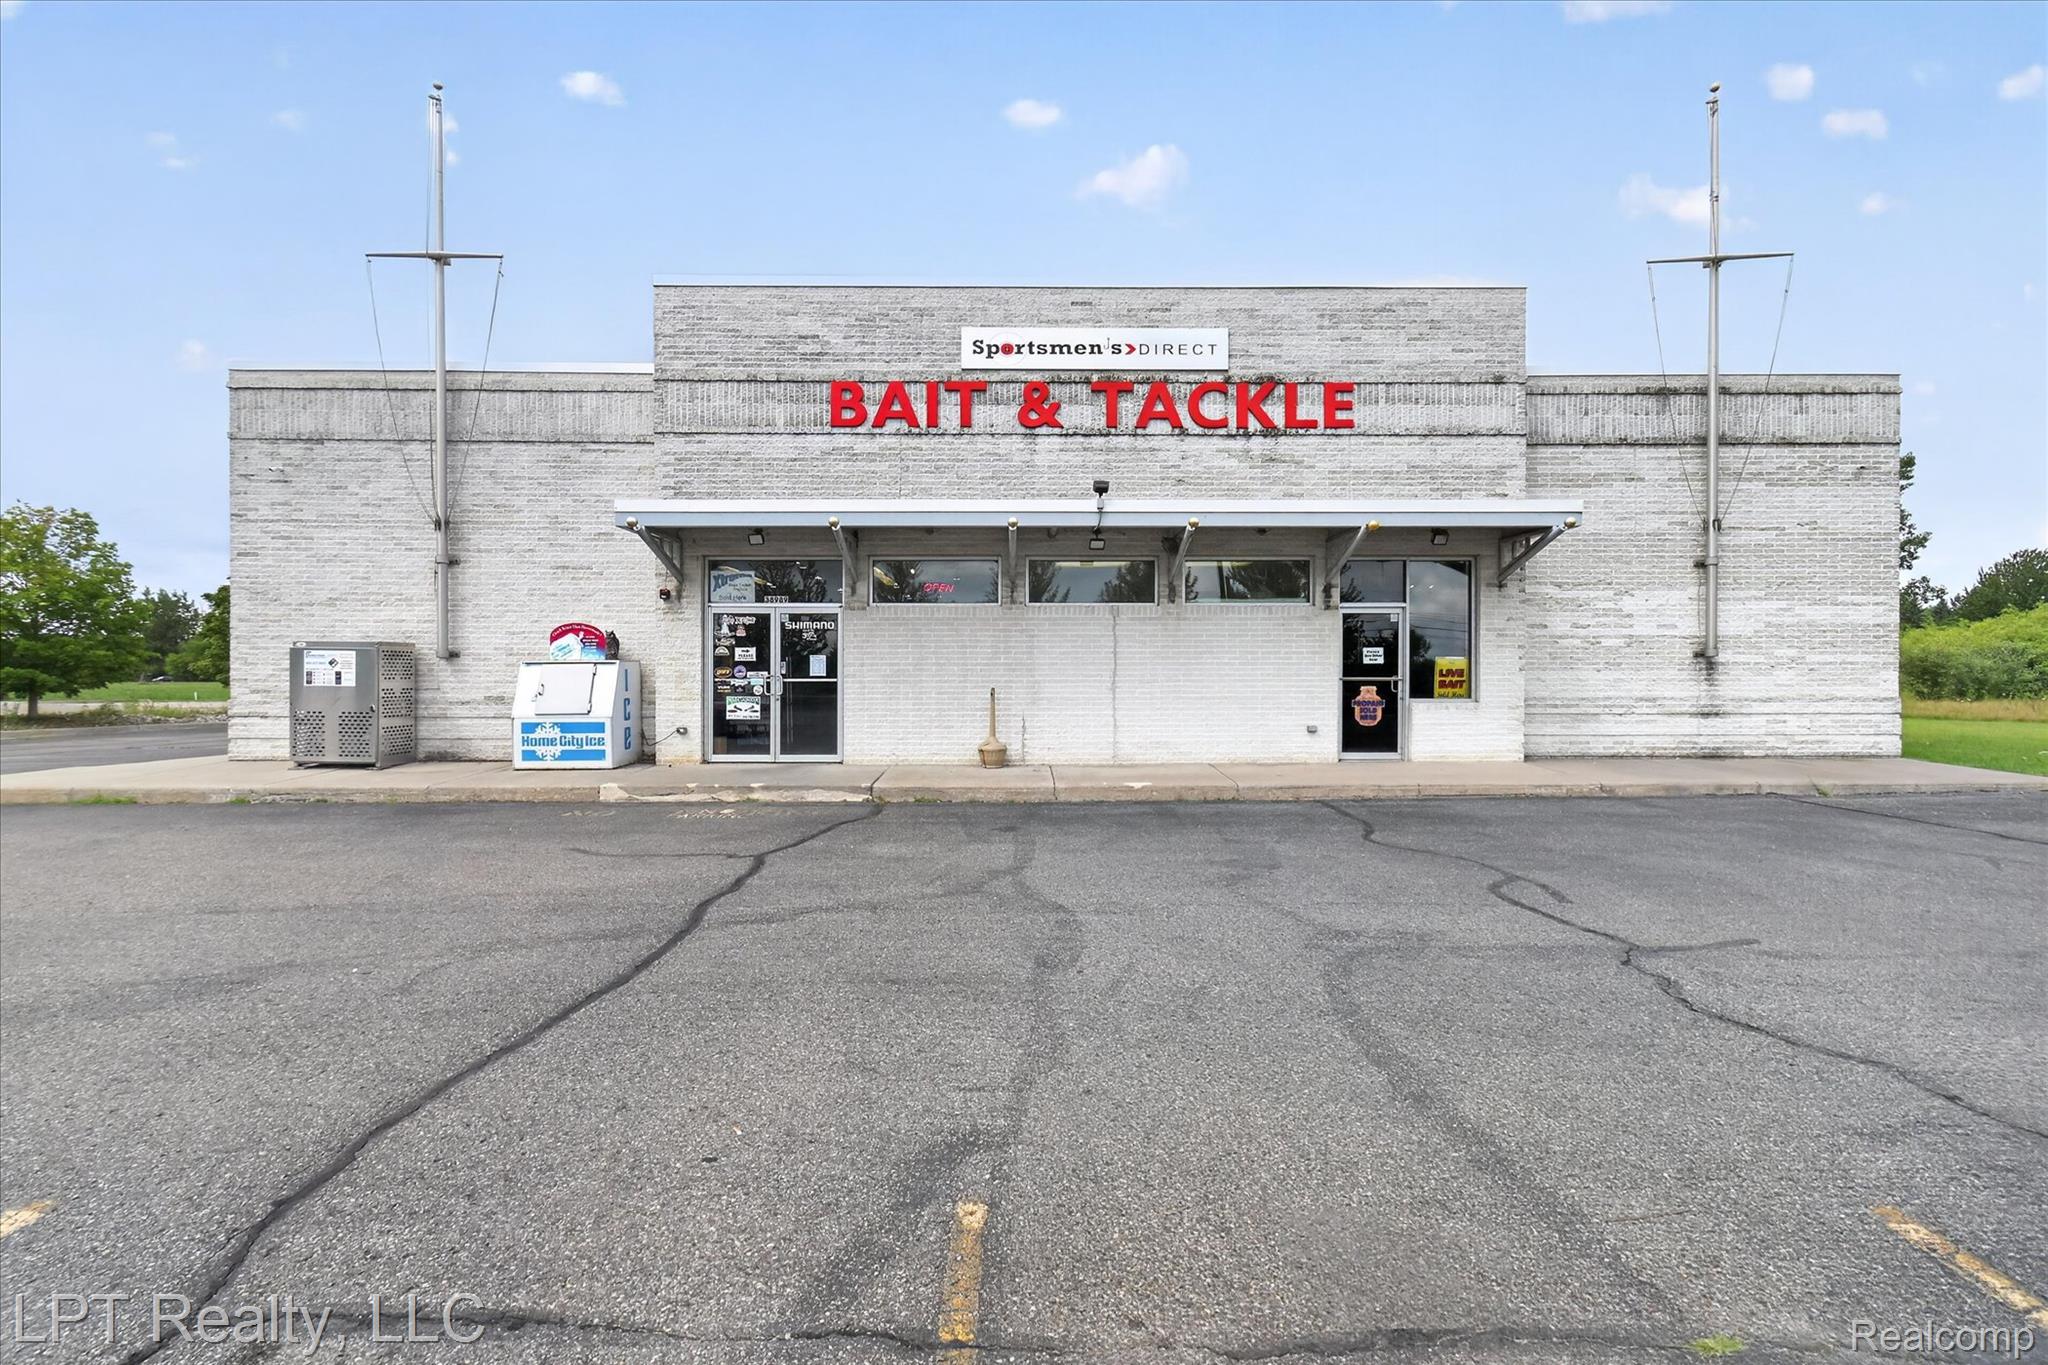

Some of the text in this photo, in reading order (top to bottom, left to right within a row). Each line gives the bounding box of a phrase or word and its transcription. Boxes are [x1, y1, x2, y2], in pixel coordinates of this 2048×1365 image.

[972, 337, 1217, 360] Sportsmen's DIRECT
[830, 381, 1355, 430] BAIT & TACKLE
[923, 583, 955, 593] OPEN
[784, 621, 835, 630] SHIMANO
[1438, 668, 1465, 678] LIVE
[1438, 679, 1466, 689] BAIT
[521, 735, 605, 749] Home City Ice
